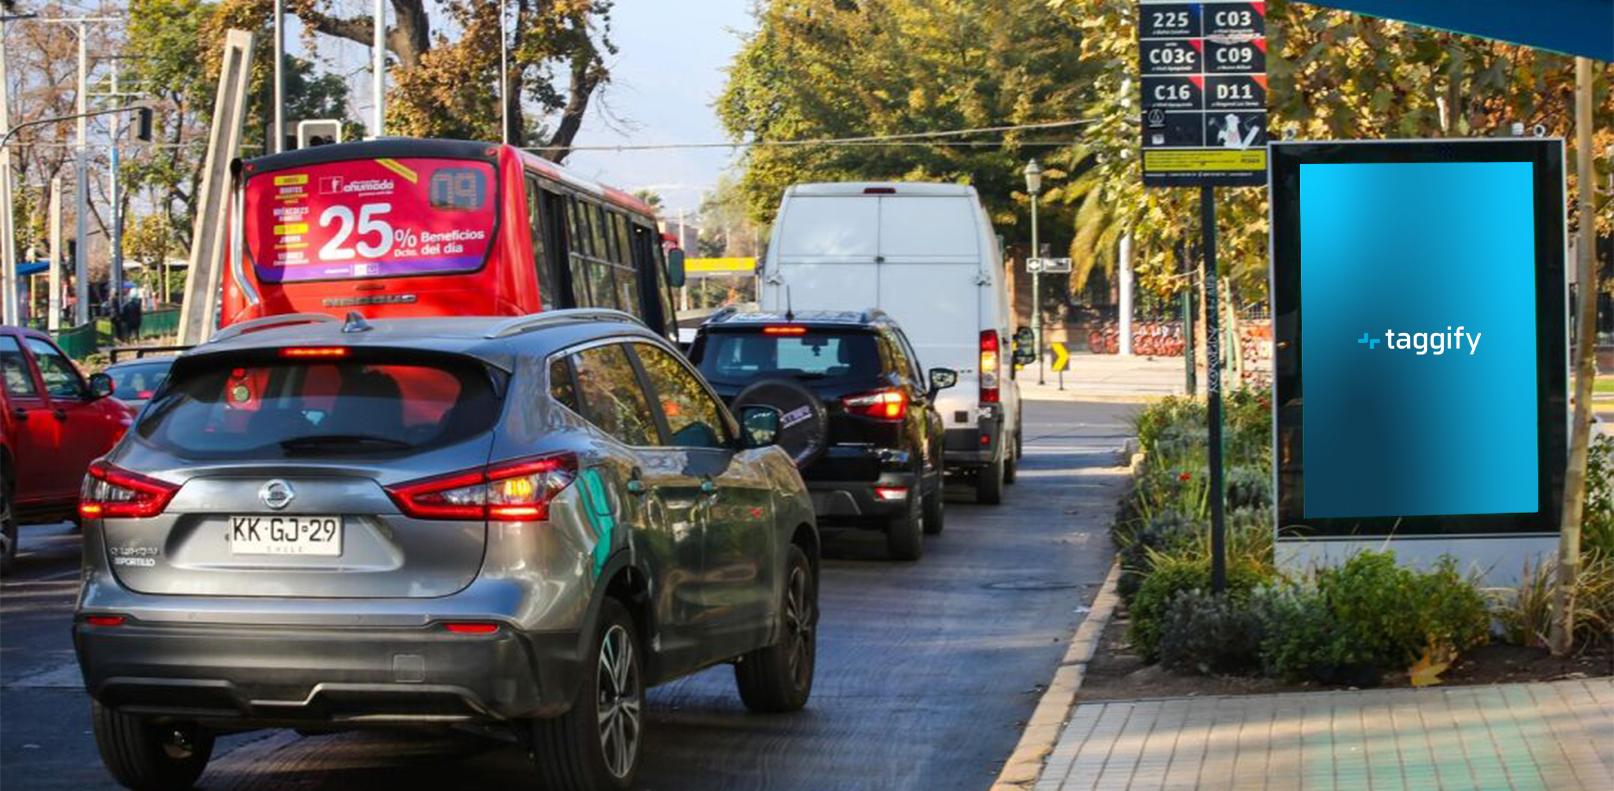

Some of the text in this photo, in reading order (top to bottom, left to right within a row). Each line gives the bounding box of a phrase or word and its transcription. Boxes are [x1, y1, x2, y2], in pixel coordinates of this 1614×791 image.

[1153, 12, 1189, 27] 225
[1215, 11, 1252, 26] C03
[1149, 49, 1195, 63] C03c
[1216, 48, 1252, 62] C09
[1154, 85, 1190, 100] C16
[1217, 84, 1253, 99] D11
[421, 230, 485, 243] Beneficios
[421, 244, 440, 256] del
[1385, 326, 1481, 355] taggify
